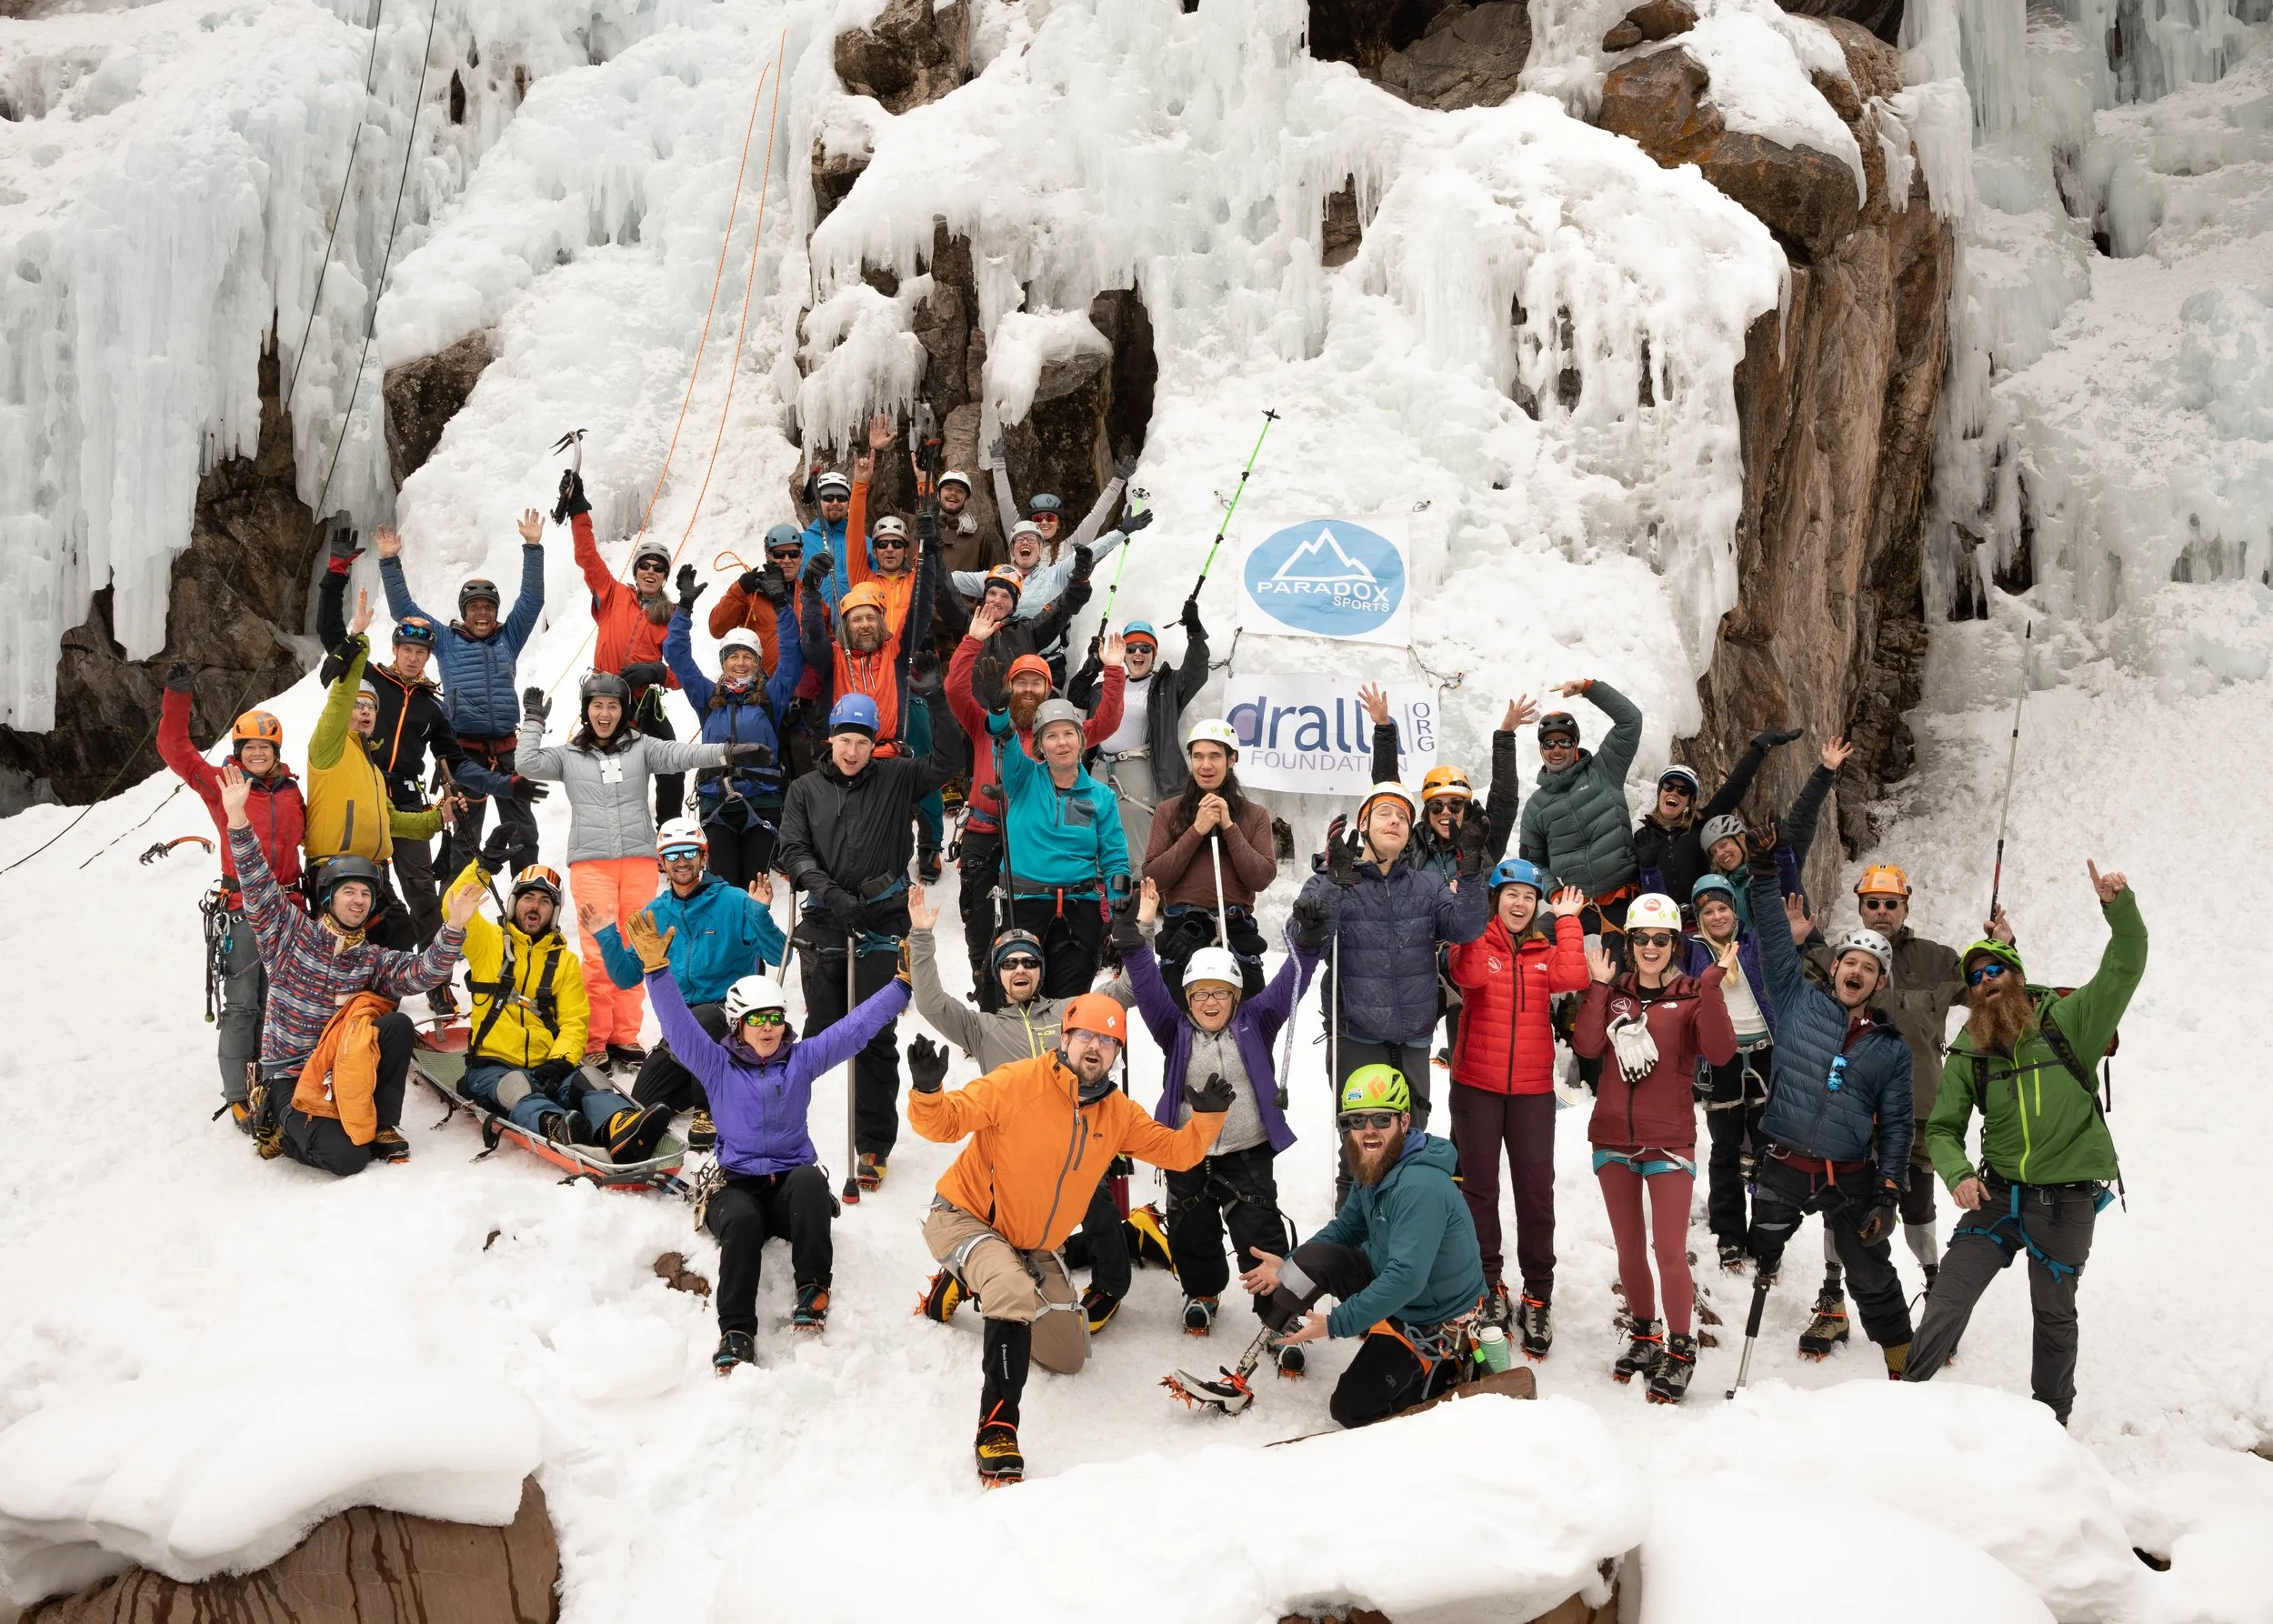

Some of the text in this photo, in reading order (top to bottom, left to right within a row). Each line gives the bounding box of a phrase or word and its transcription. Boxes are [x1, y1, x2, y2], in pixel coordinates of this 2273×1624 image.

[1257, 581, 1389, 603] PARADOX
[1333, 596, 1390, 613] SPORTS
[1412, 702, 1435, 752] ORG
[1250, 750, 1408, 773] FOUNDATIN
